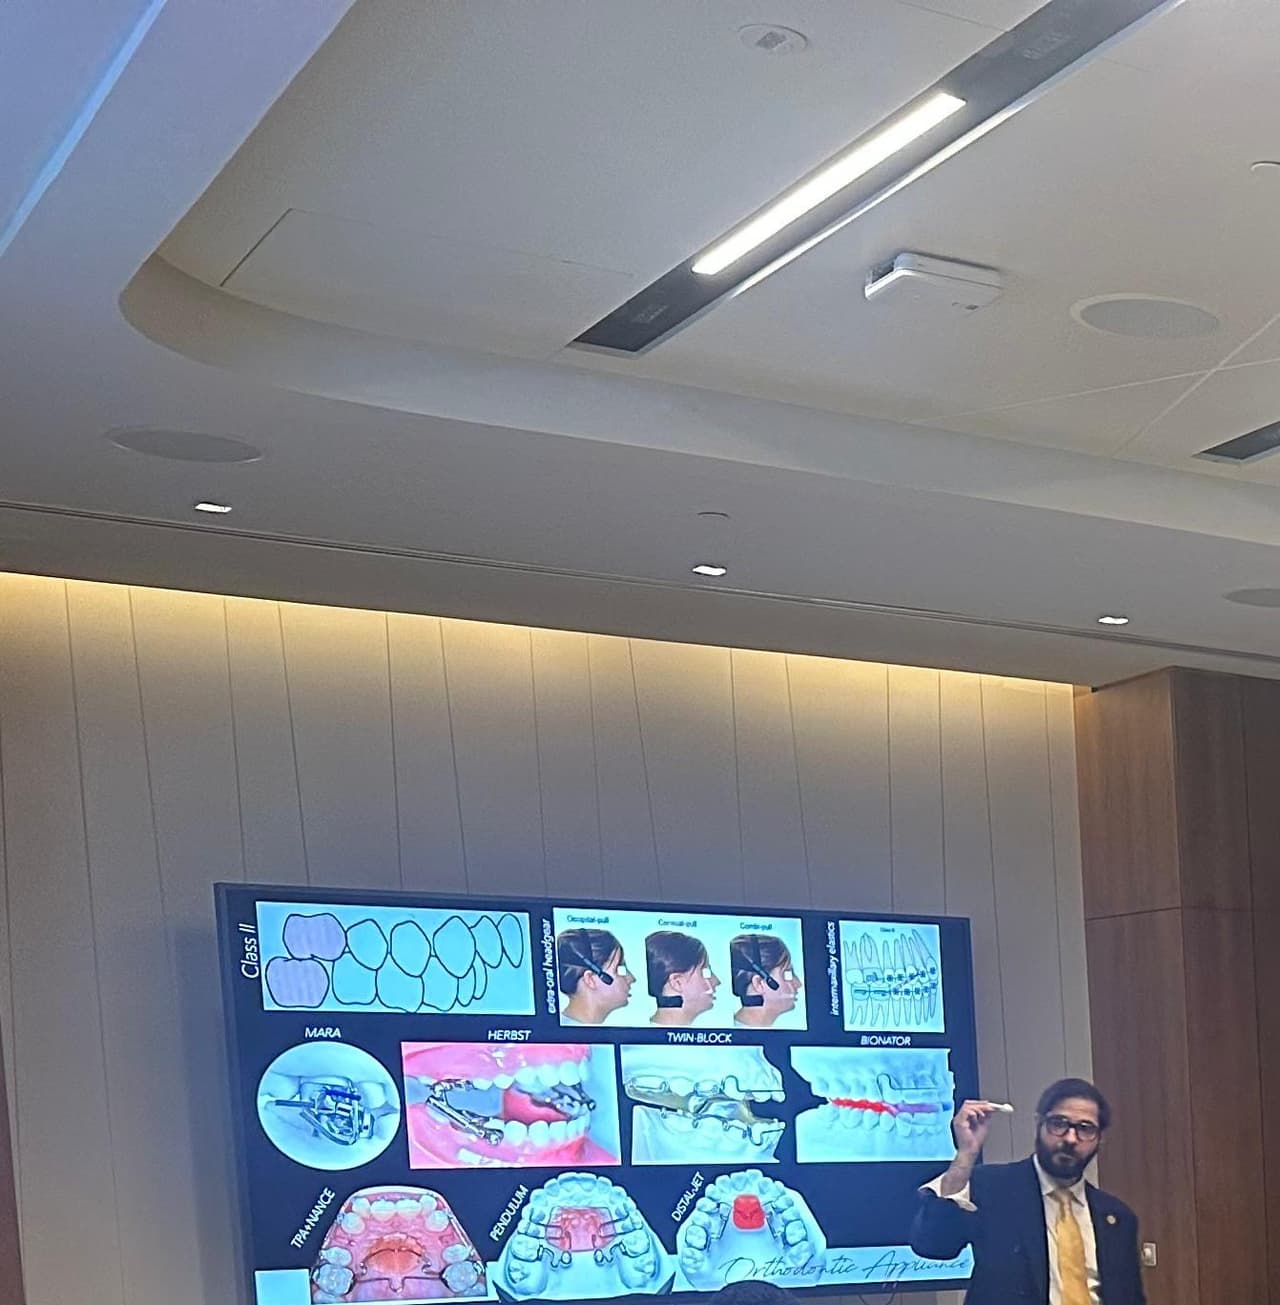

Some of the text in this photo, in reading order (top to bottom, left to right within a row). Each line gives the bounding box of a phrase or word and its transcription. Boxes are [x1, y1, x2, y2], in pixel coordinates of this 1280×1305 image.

[241, 936, 259, 978] Class
[541, 918, 554, 967] headgear
[305, 1026, 341, 1038] MARA
[488, 1029, 531, 1041] HERBST
[861, 1035, 911, 1046] BIONATOR
[490, 1184, 529, 1241] PENDULUM
[718, 1253, 856, 1283] Orthodontic
